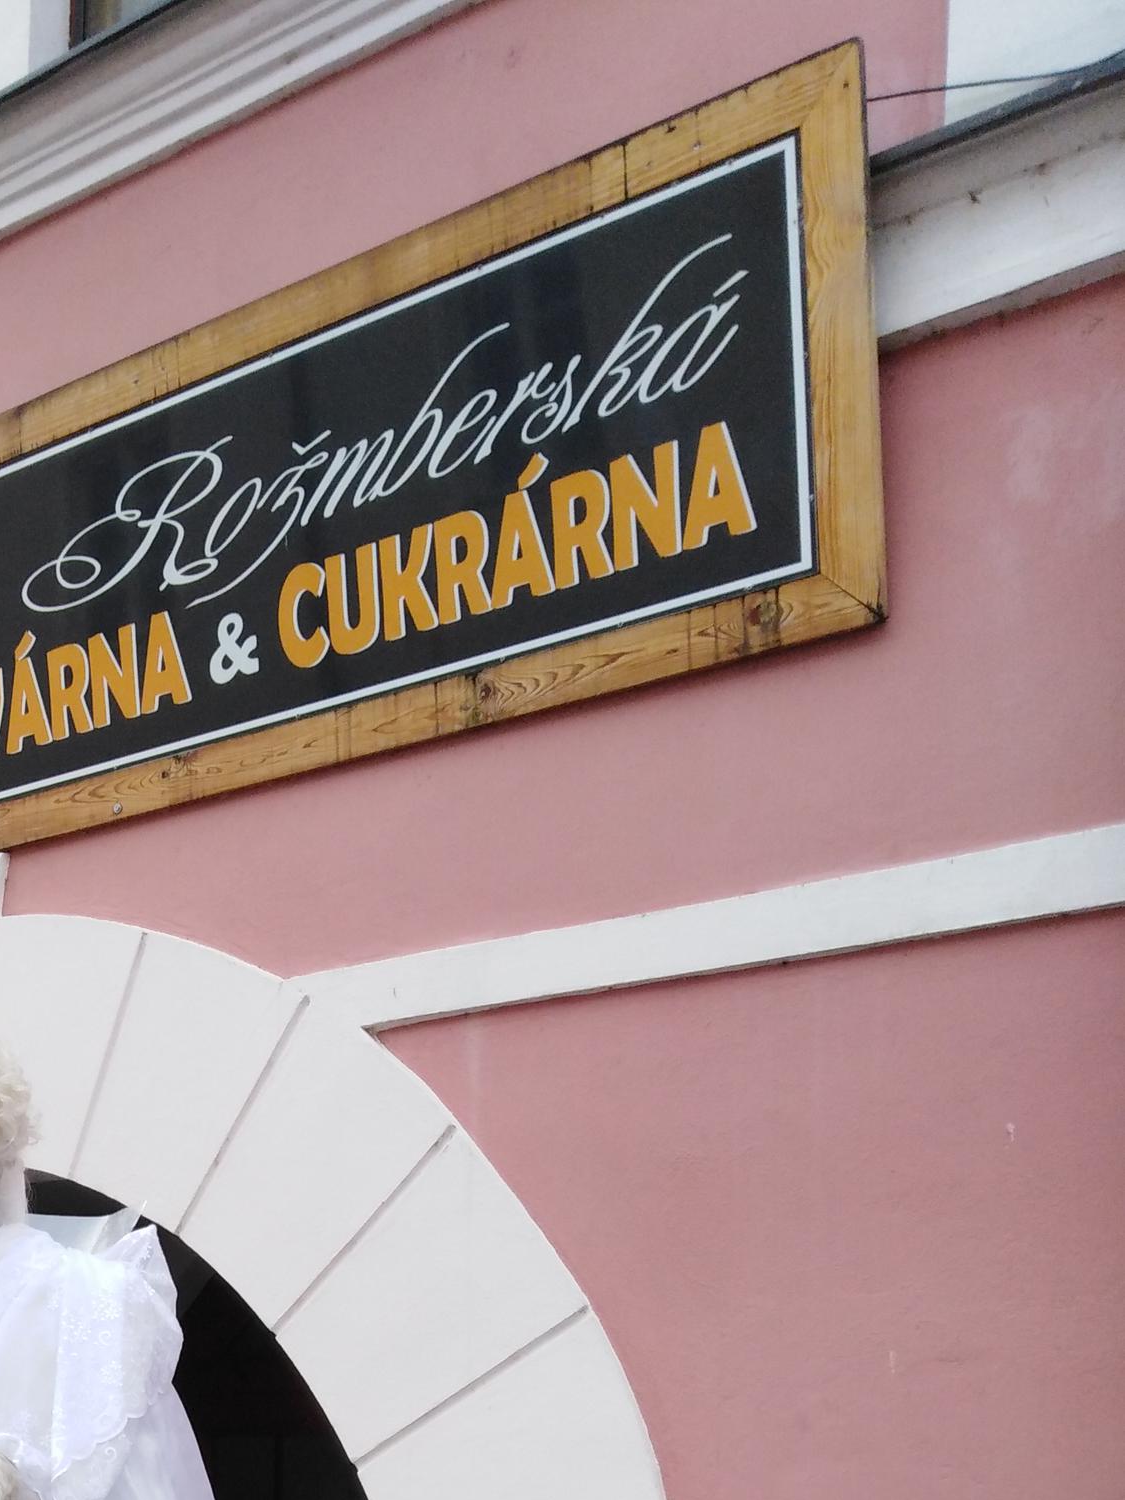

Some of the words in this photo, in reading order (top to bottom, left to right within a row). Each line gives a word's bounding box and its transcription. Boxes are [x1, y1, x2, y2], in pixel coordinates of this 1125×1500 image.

[22, 233, 749, 613] Rožmberská
[209, 612, 260, 685] &
[277, 421, 757, 669] CUKRÁRNA
